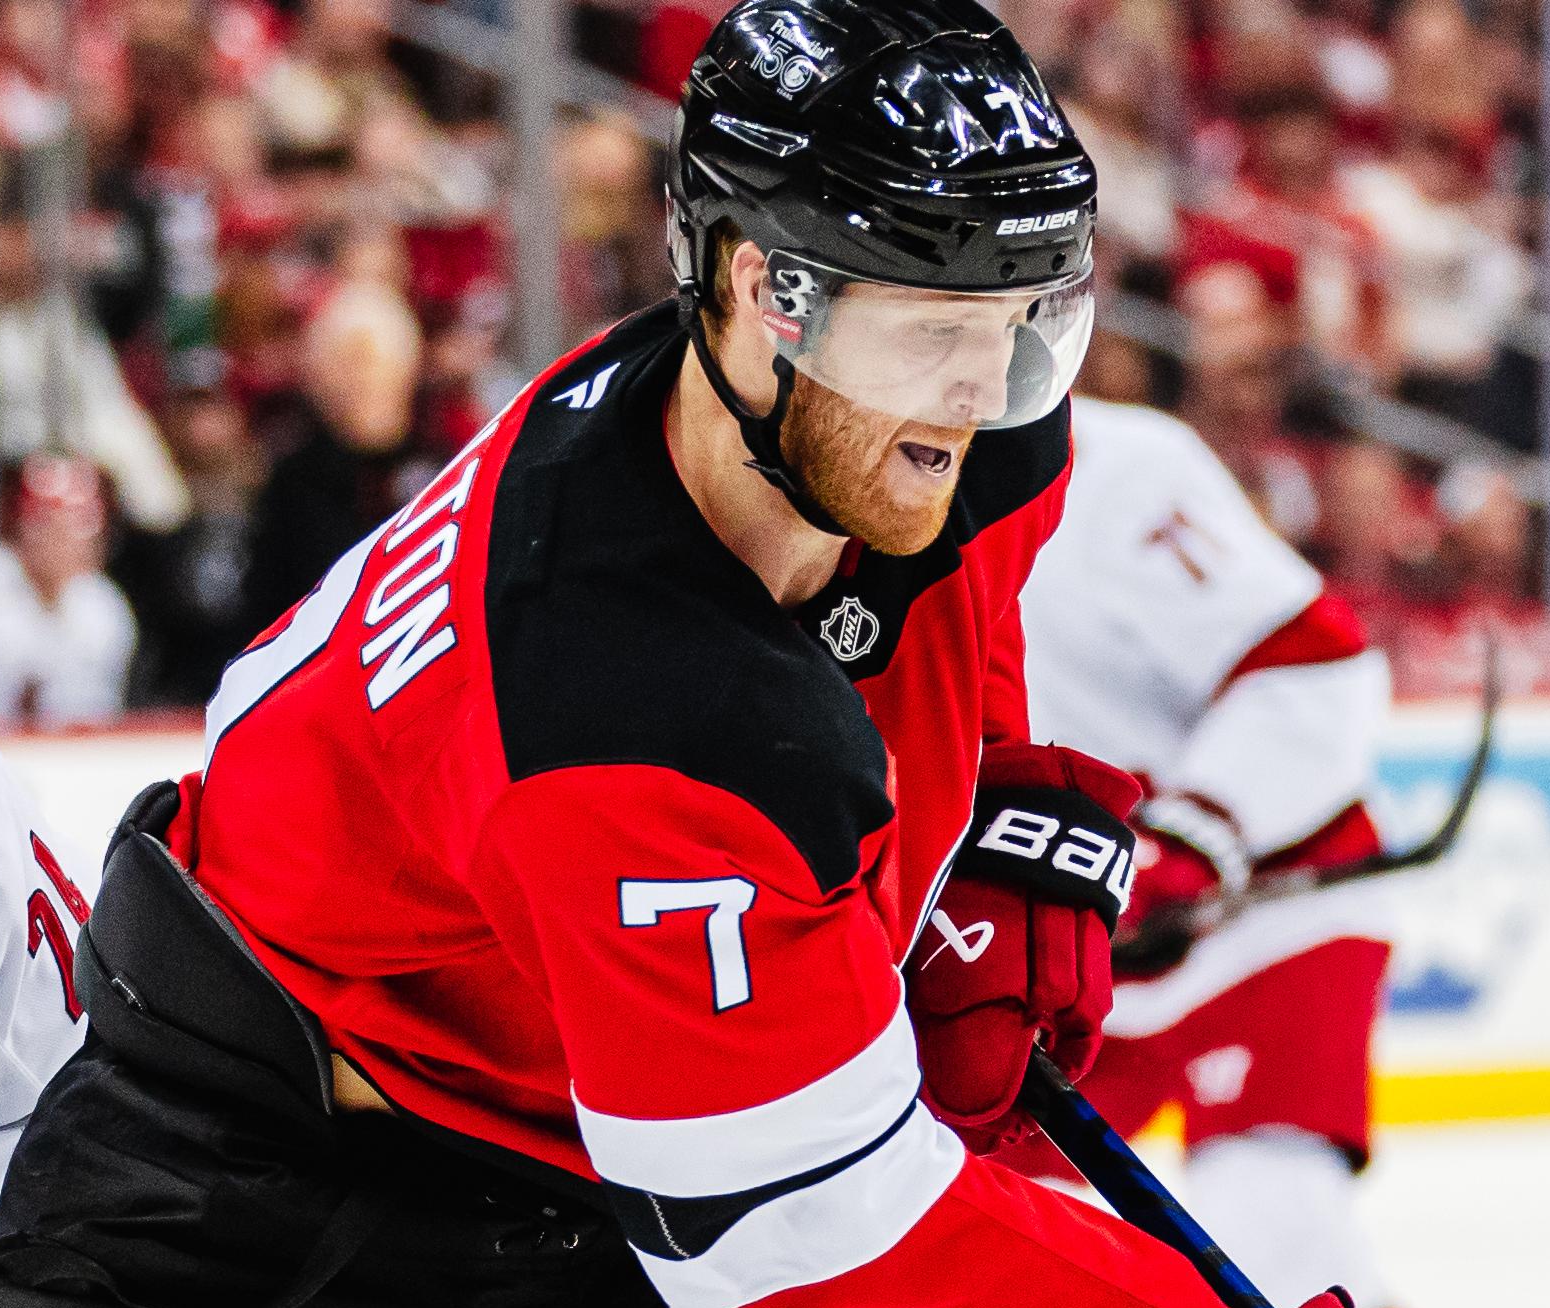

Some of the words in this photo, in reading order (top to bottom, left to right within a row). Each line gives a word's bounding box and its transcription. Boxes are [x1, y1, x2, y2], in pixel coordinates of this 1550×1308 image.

[984, 91, 1036, 149] 7
[359, 420, 500, 712] TON
[618, 876, 757, 1013] 7
